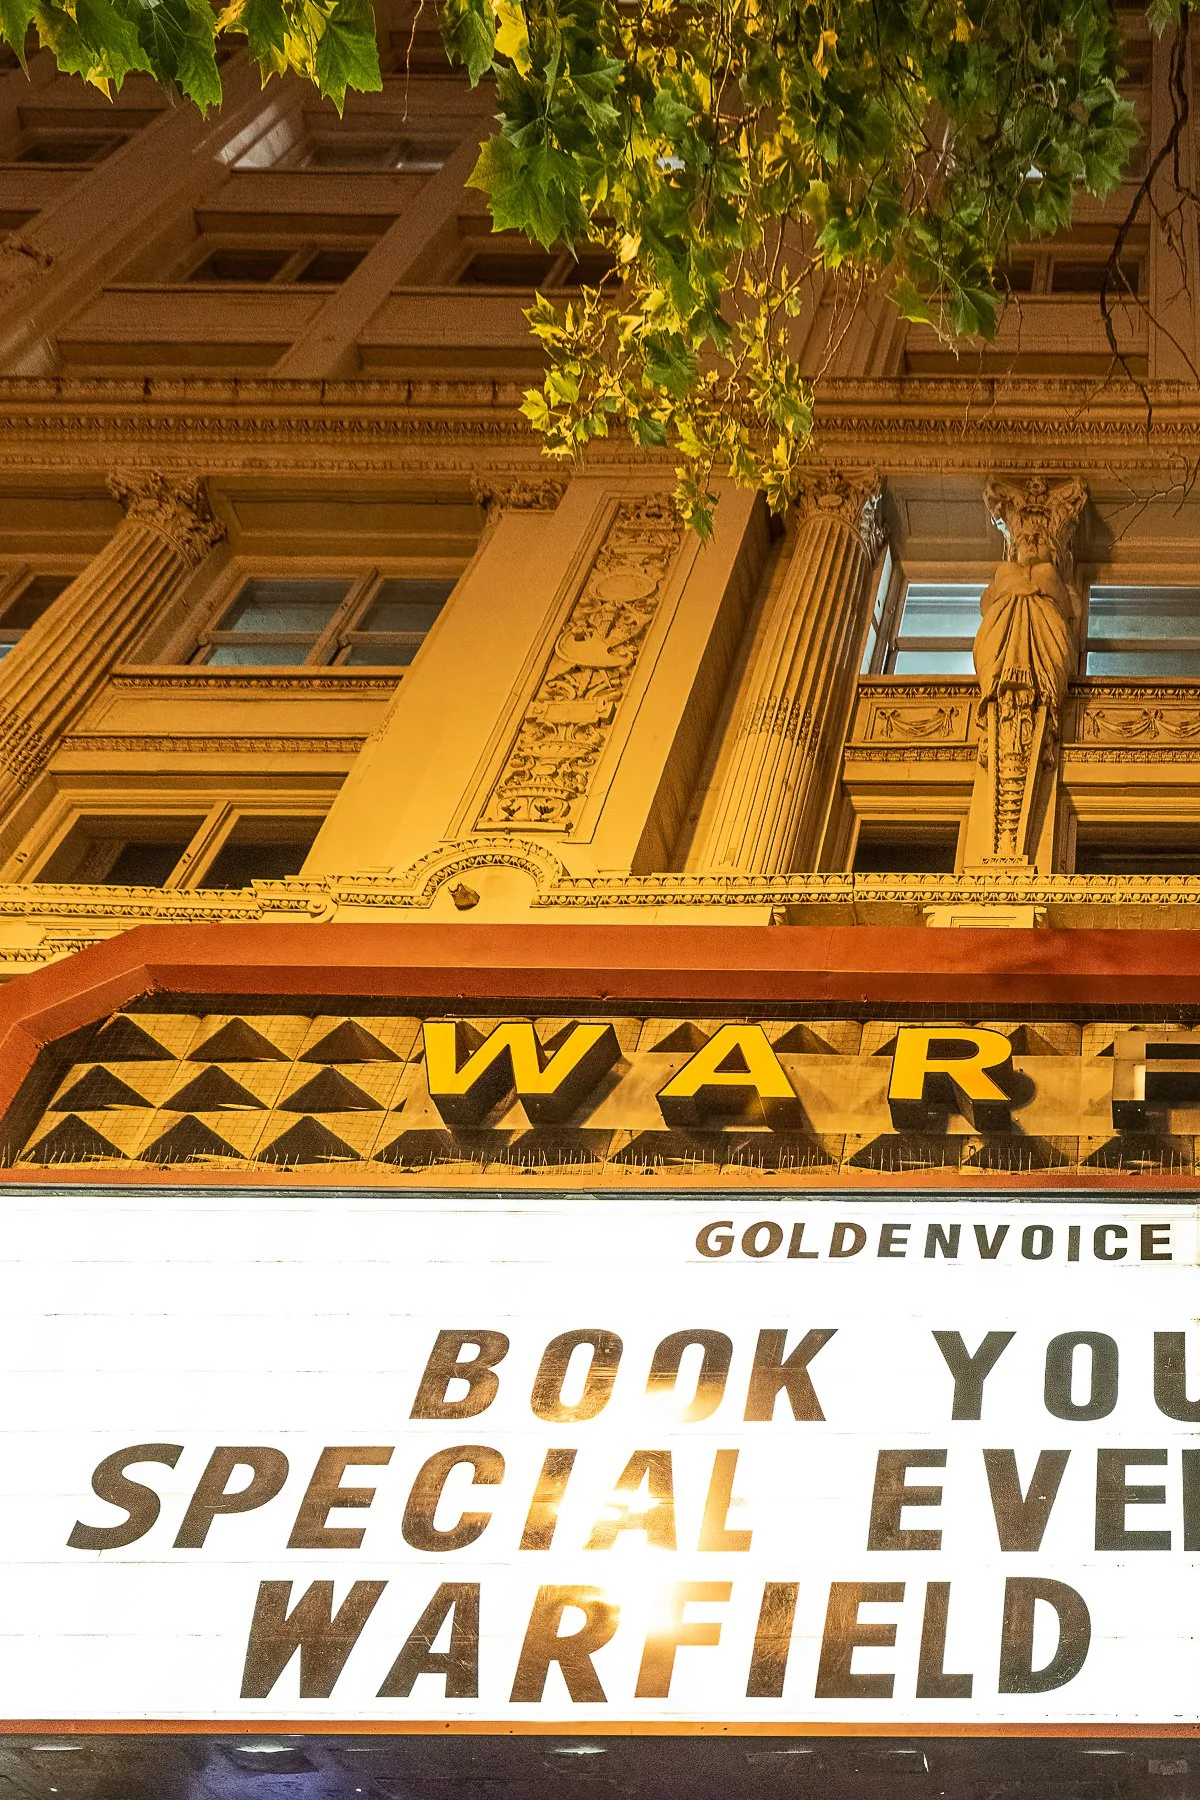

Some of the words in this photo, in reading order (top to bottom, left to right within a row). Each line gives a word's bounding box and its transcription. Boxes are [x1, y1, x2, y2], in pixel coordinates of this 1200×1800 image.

[695, 1220, 1174, 1262] GOLDENVOICE
[408, 1328, 839, 1424] BOOK
[65, 1442, 754, 1554] SPECIAL
[239, 1576, 1092, 1704] WARFIELD
